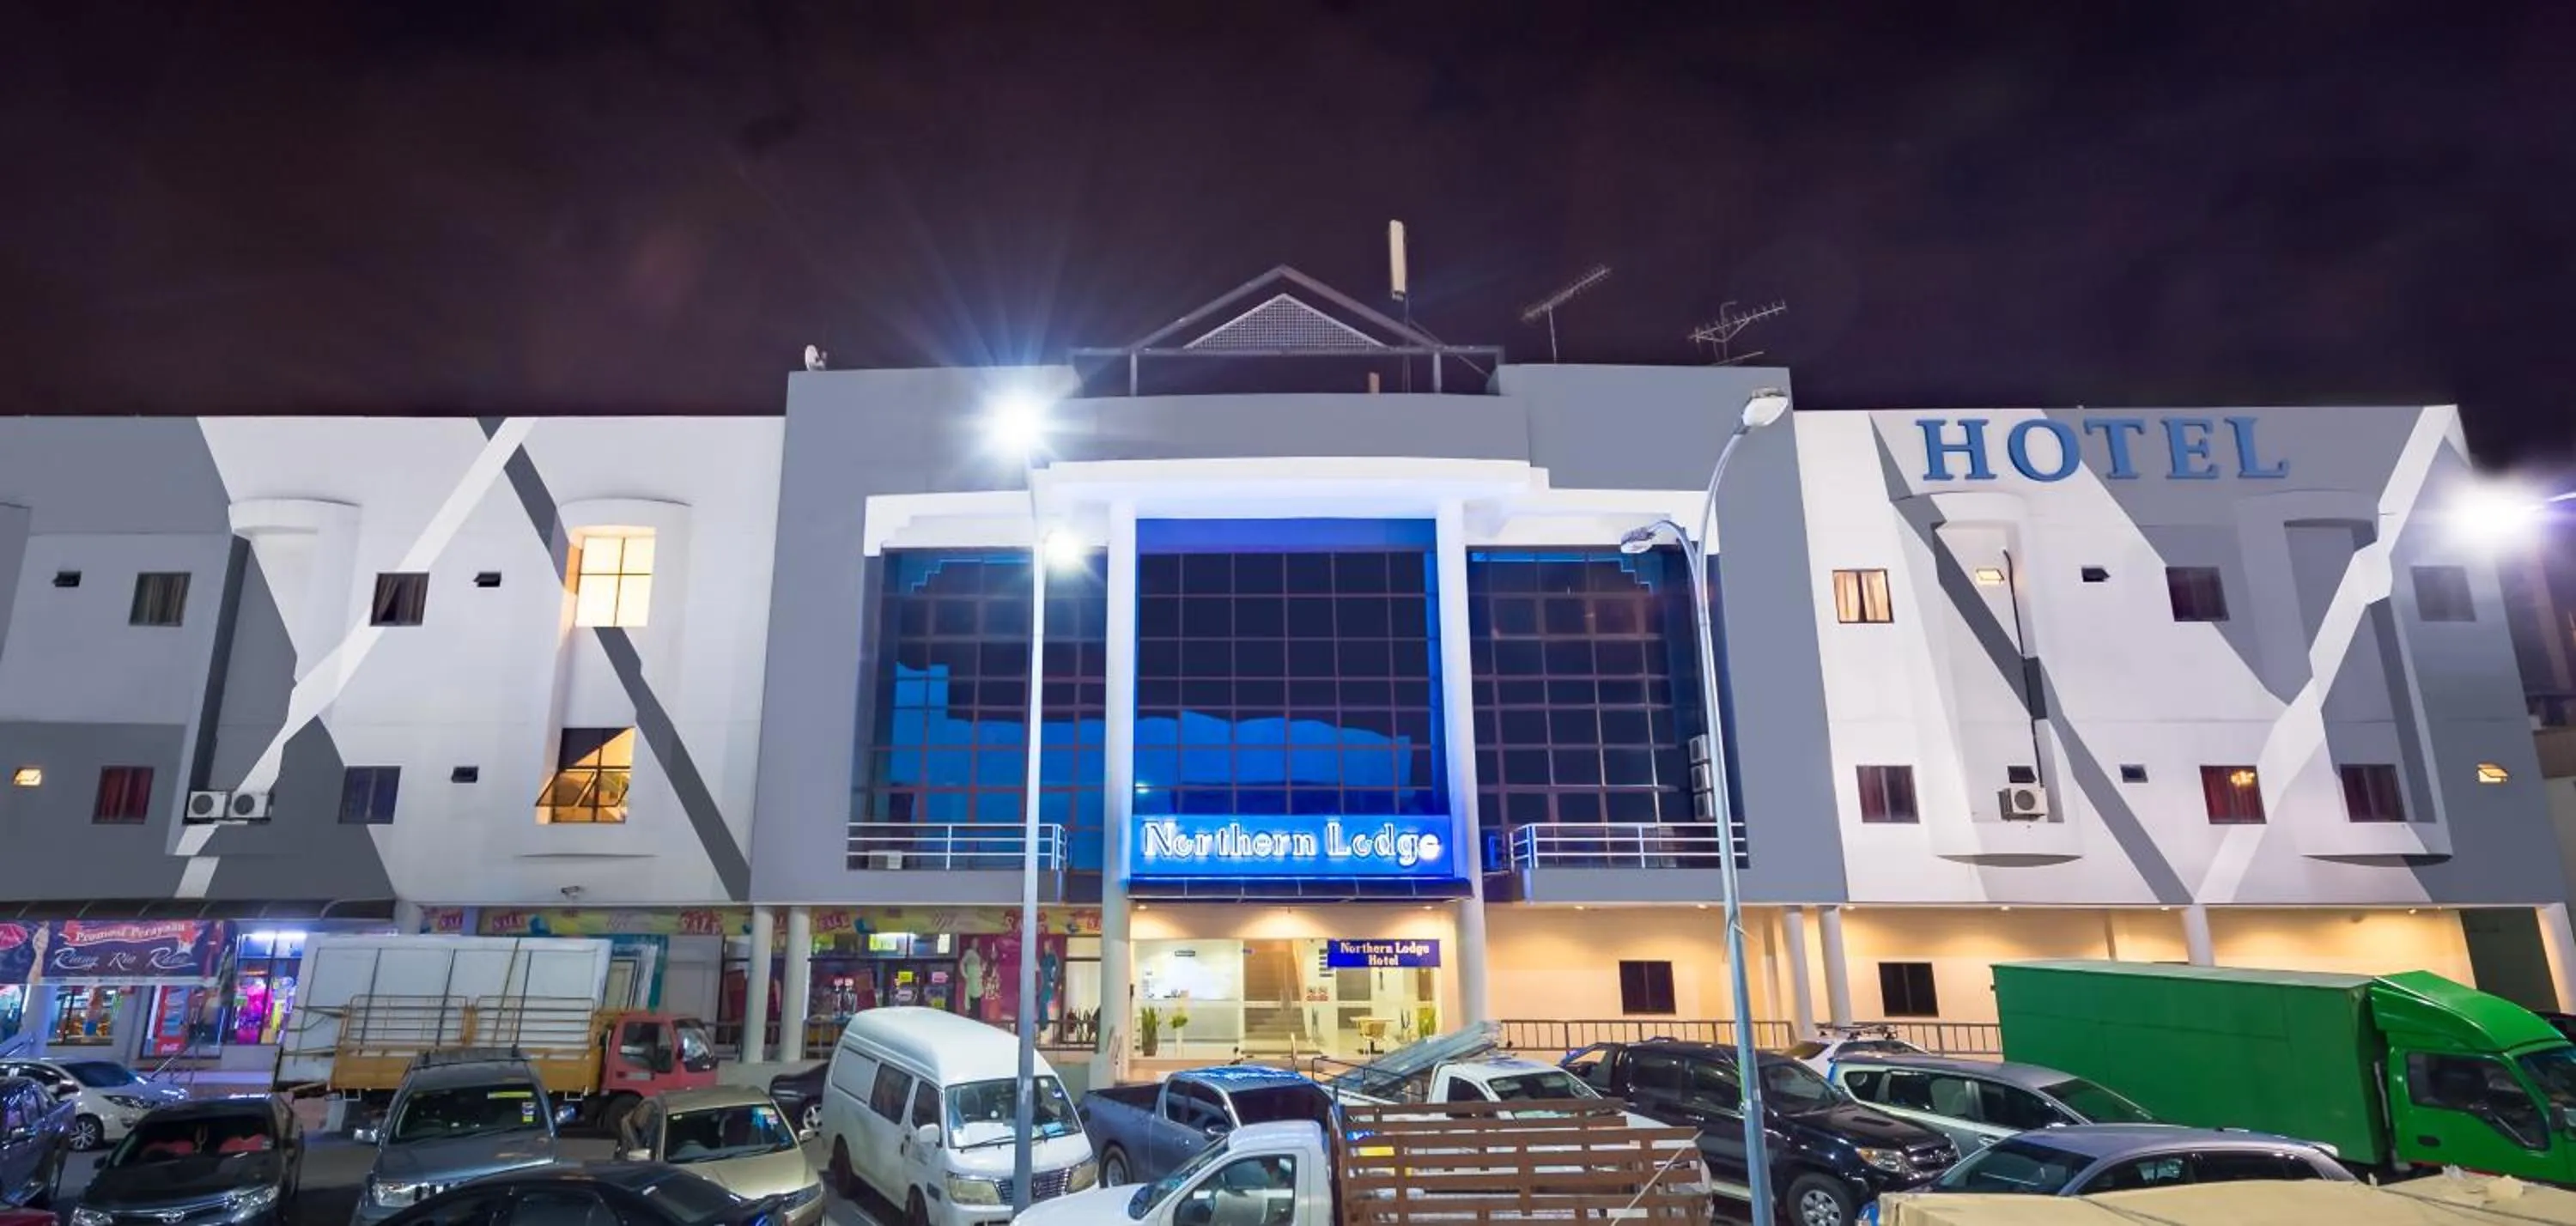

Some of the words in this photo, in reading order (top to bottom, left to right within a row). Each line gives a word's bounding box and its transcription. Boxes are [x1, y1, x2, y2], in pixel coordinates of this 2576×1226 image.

[1915, 416, 2290, 482] HOTEL
[1143, 820, 1316, 859] Northern
[1326, 820, 1441, 866] Lodge
[1340, 941, 1393, 954] Northern
[1395, 941, 1430, 956] Lodge
[1368, 954, 1399, 966] Hotel
